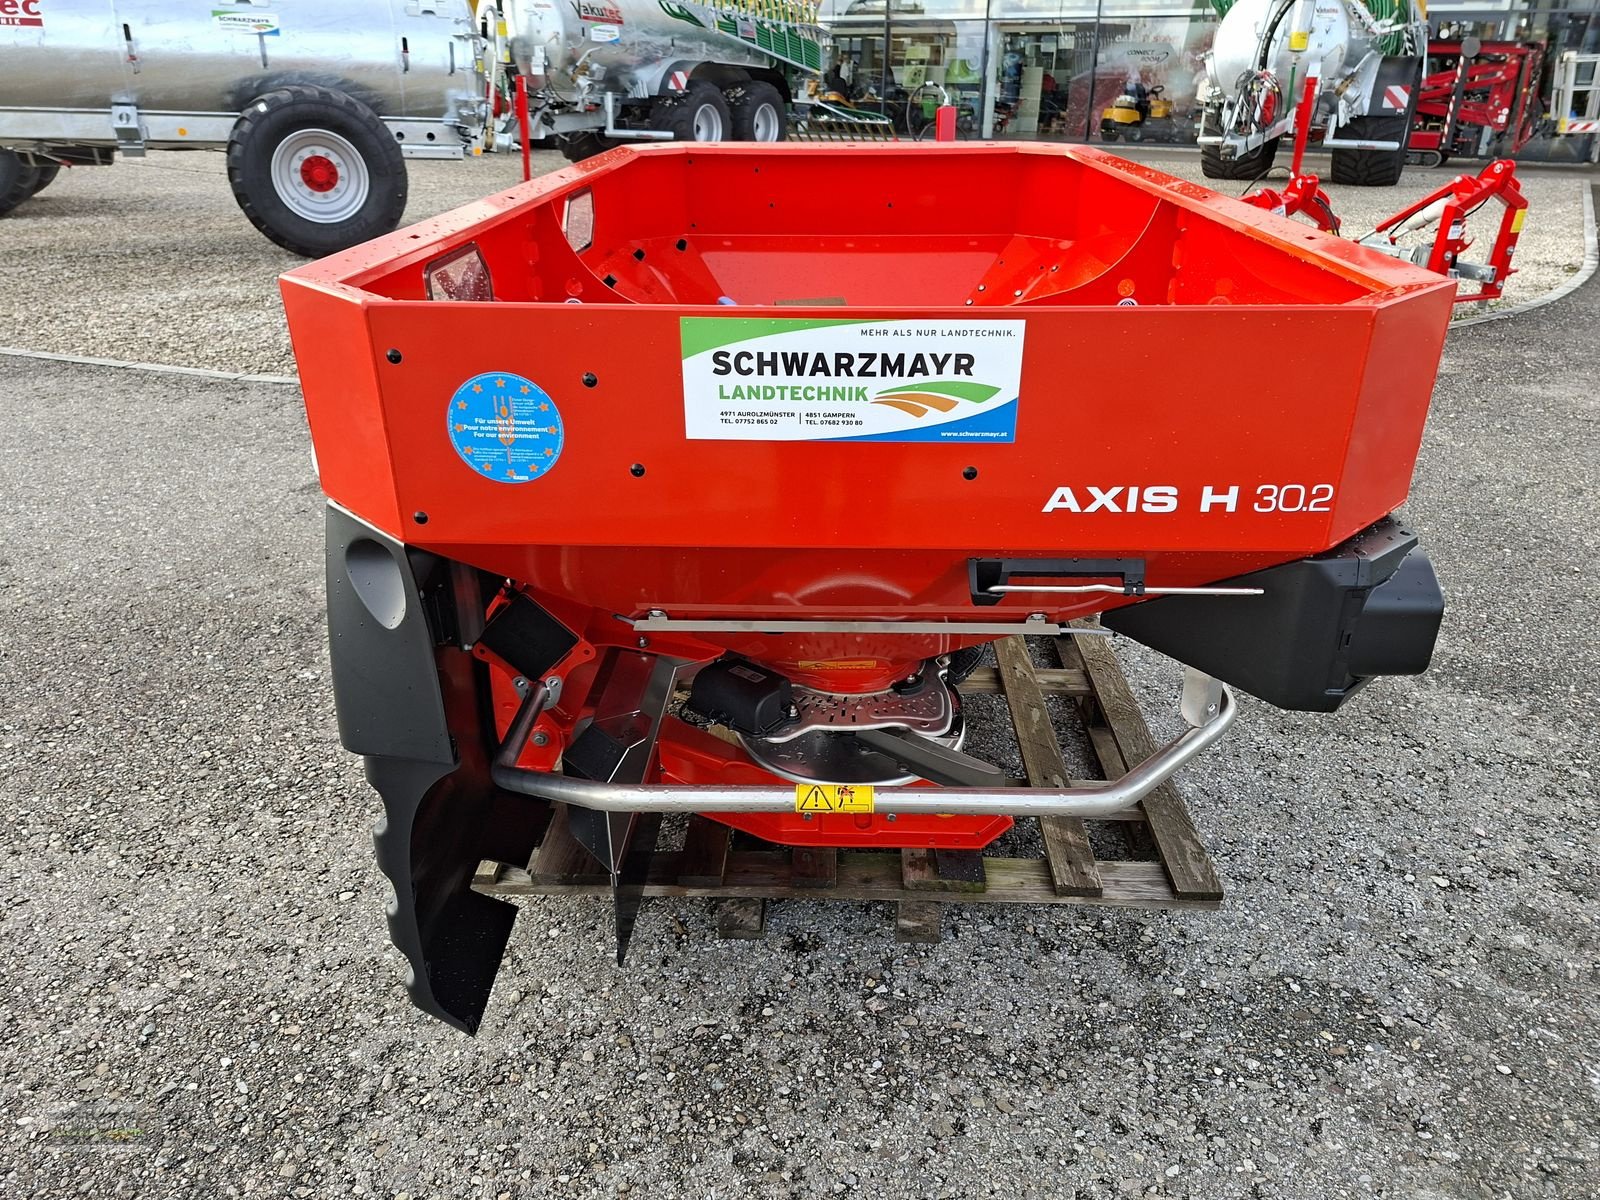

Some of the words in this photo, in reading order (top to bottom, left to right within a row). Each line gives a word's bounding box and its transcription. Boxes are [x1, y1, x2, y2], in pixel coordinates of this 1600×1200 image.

[569, 0, 623, 20] Vakutec
[860, 328, 889, 337] MEHR
[892, 328, 913, 337] ALS
[916, 328, 937, 338] NUR
[940, 328, 1016, 338] LANDTECHNIK.
[711, 350, 976, 378] SCHWARZMAYR
[718, 384, 869, 403] LANDTECHNIK
[498, 425, 549, 433] environnement
[940, 430, 1008, 439] www.schwarzmayr.at
[1041, 485, 1179, 513] AXIS
[1199, 485, 1240, 513] H
[1253, 483, 1335, 513] 30.2
